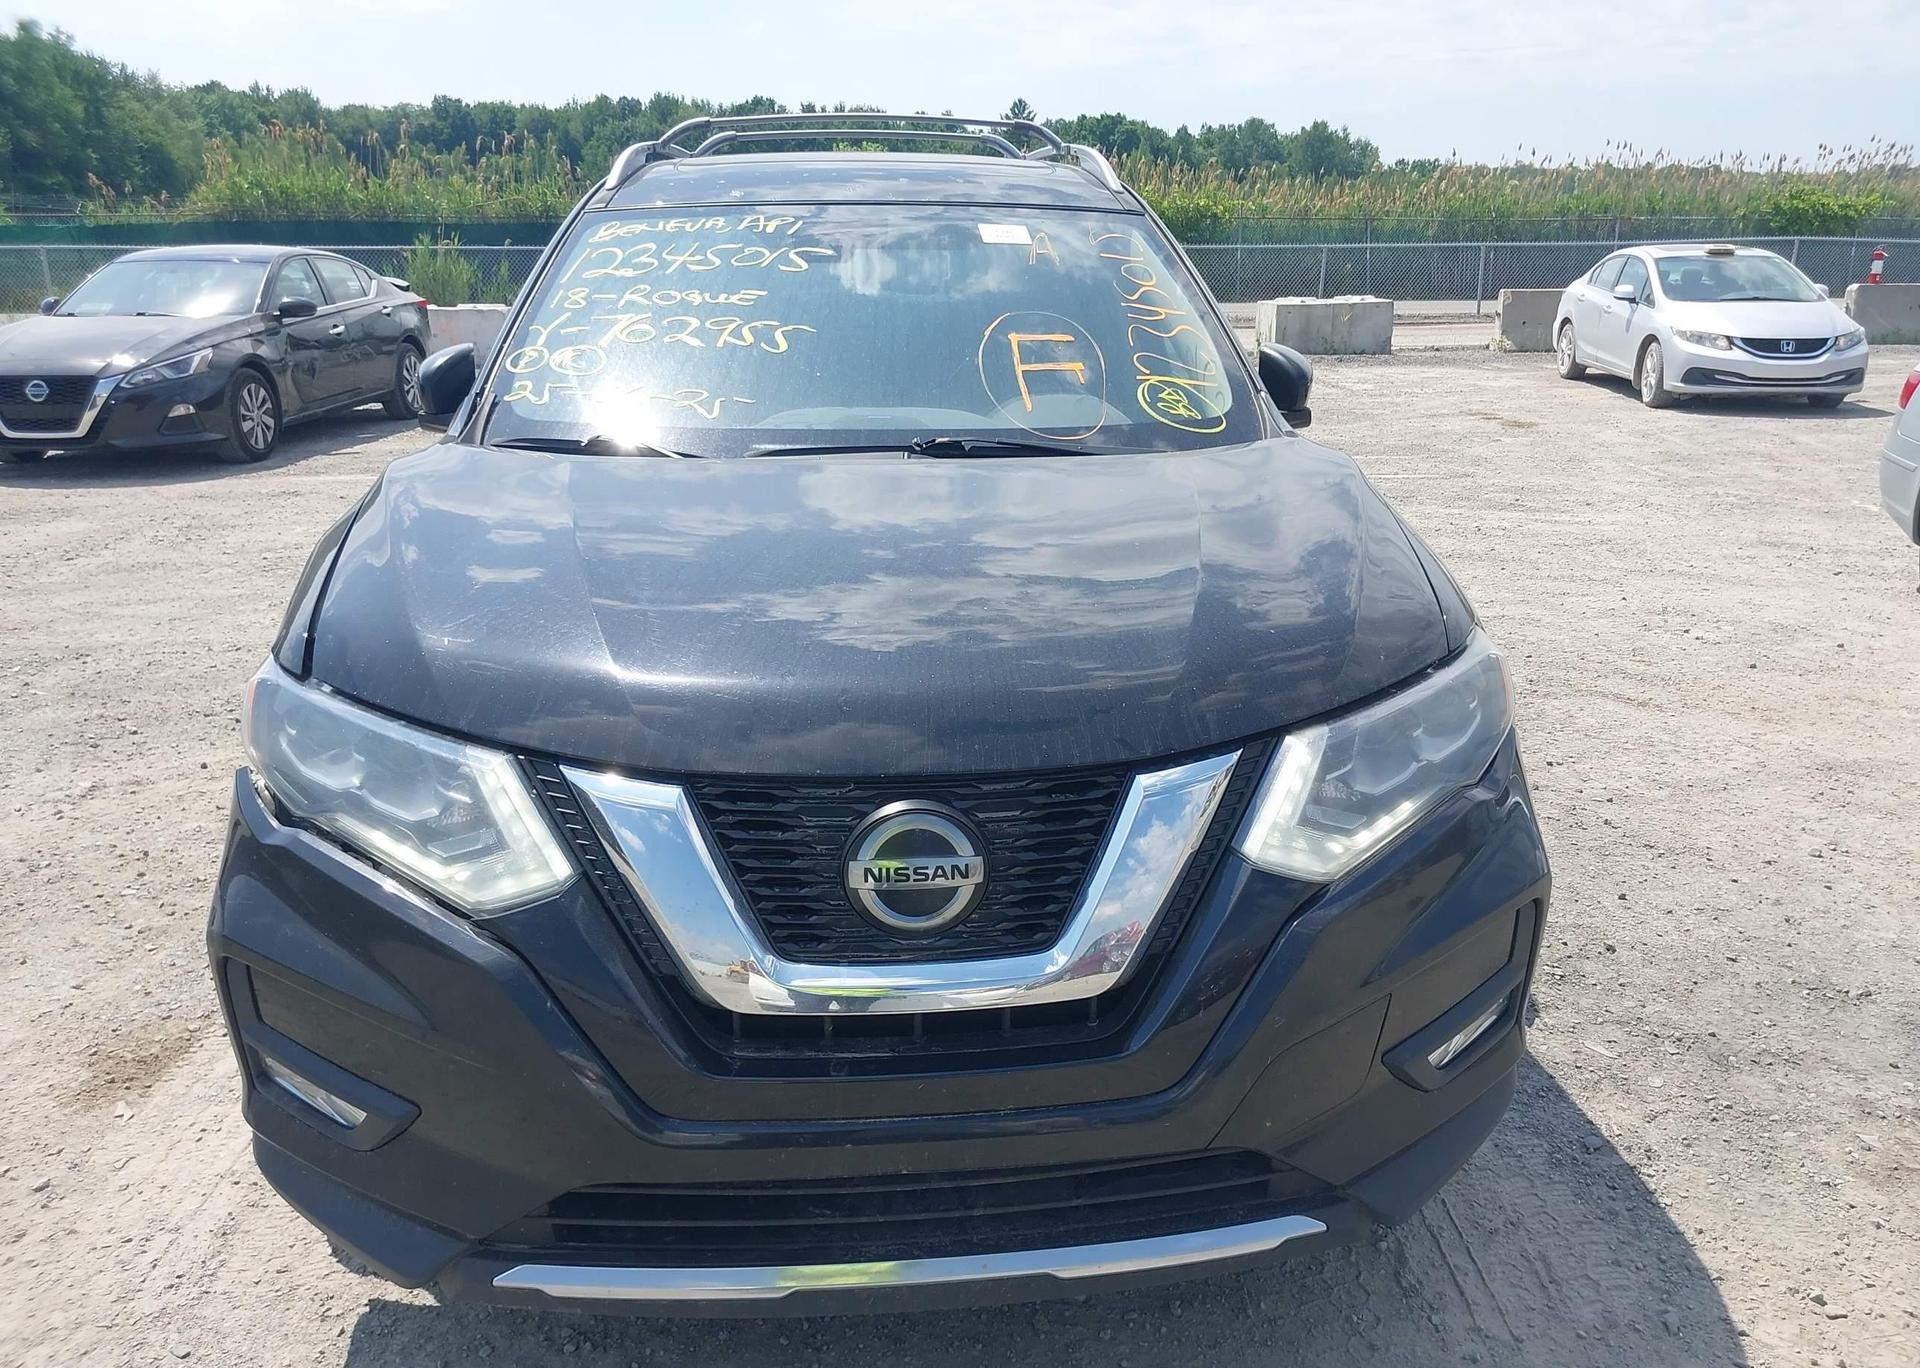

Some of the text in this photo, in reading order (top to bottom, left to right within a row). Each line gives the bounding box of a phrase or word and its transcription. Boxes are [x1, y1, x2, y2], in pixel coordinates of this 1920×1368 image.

[560, 242, 837, 284] 12345015
[1007, 331, 1085, 413] F
[863, 863, 970, 884] NISSAN
